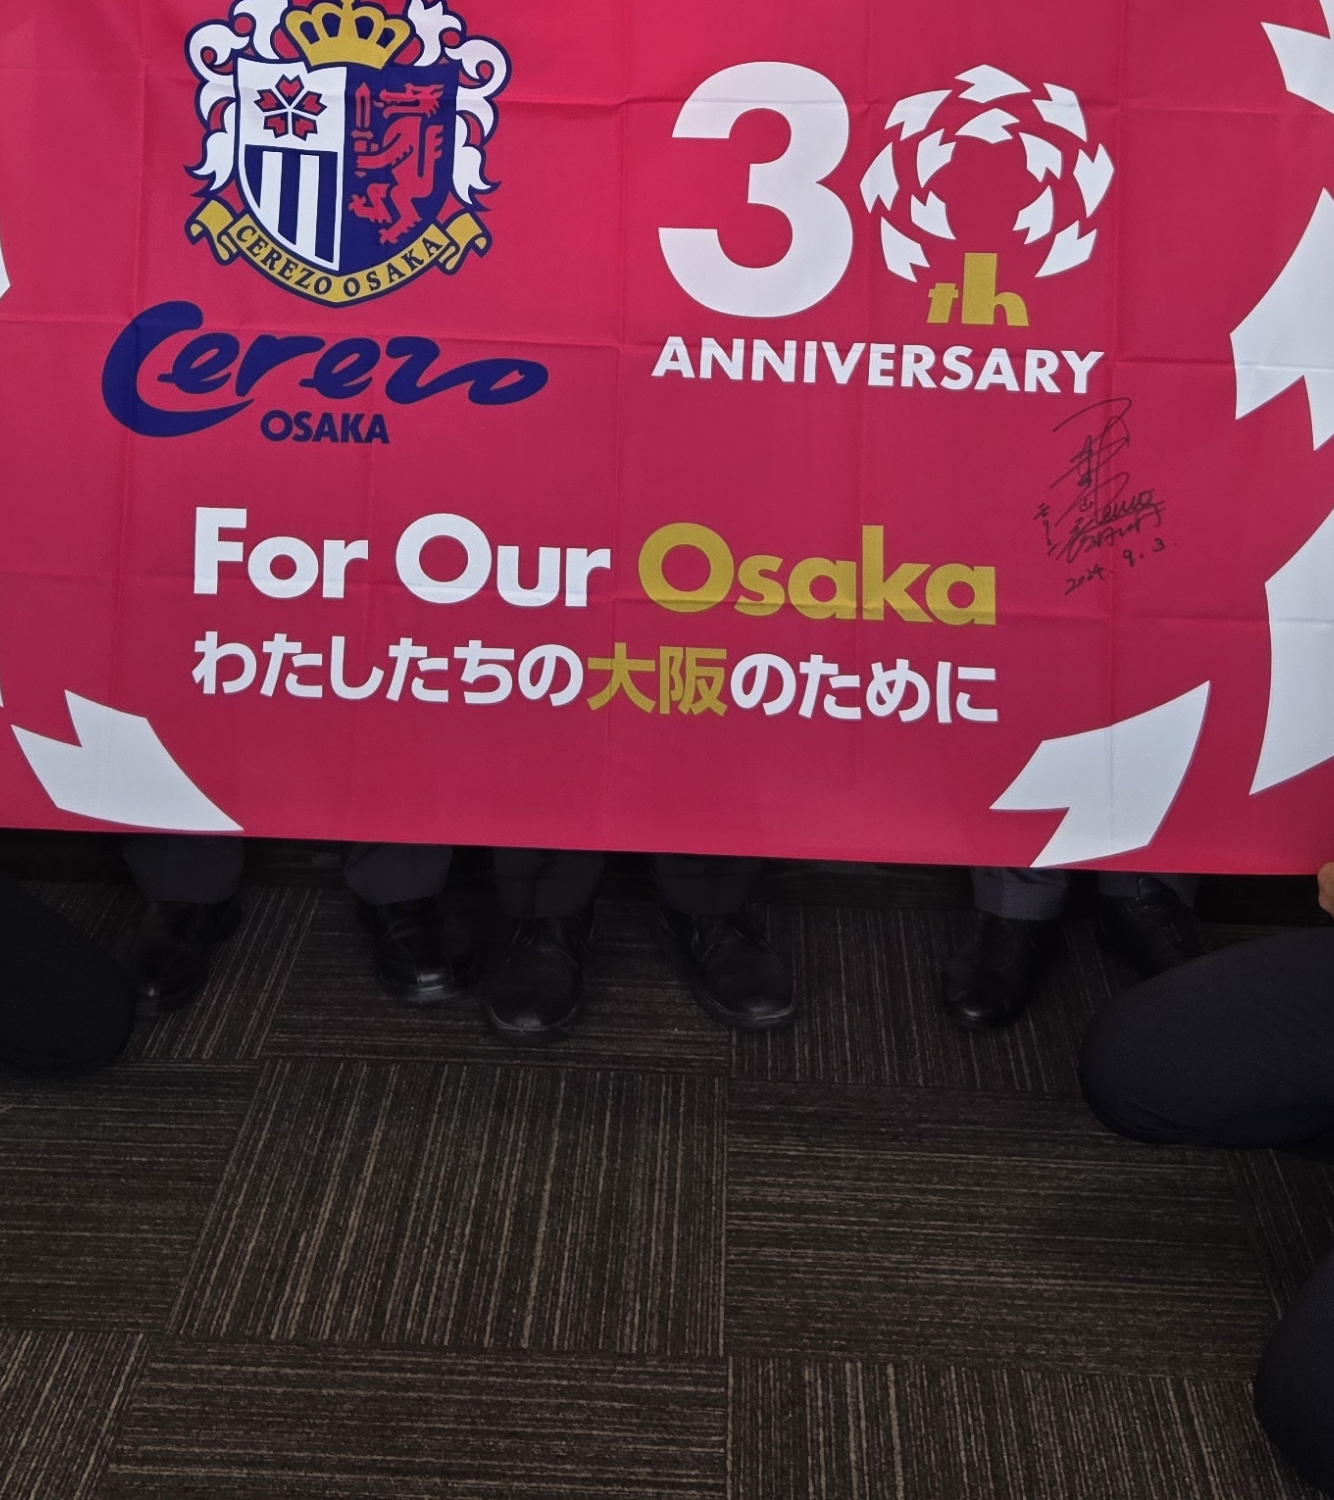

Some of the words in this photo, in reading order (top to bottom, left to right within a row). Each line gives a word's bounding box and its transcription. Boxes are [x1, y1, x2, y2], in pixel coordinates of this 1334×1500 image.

[235, 225, 332, 295] CEREZO
[343, 236, 443, 297] OSAKA
[101, 300, 550, 437] Cerezo
[651, 335, 1105, 394] ANNIVERSARY
[260, 409, 391, 445] OSAKA
[192, 506, 369, 600] For
[394, 512, 612, 608] Our
[637, 522, 998, 626] Osaka
[191, 630, 1000, 725] わたしたちの大阪のために
